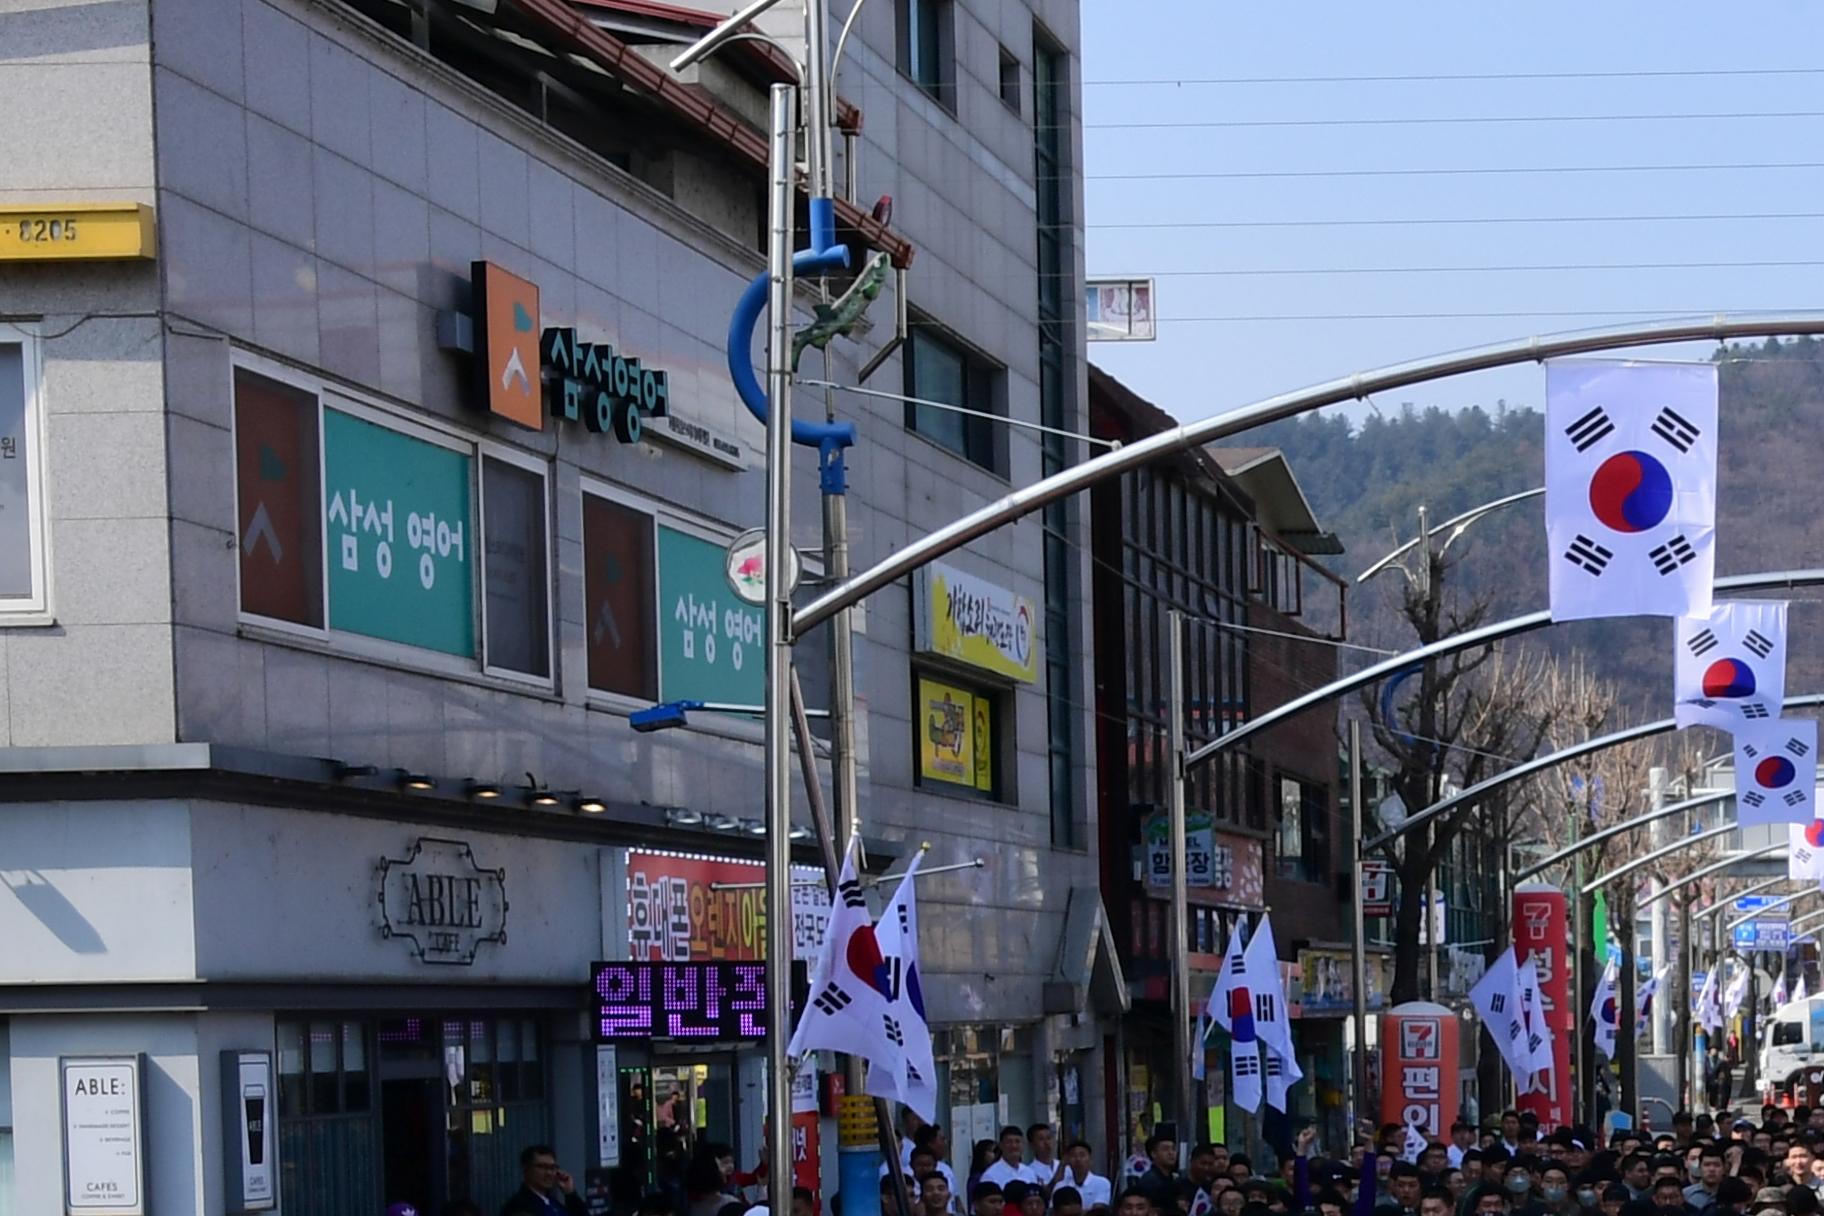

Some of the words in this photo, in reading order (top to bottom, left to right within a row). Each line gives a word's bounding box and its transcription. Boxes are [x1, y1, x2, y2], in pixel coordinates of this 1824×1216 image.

[551, 329, 671, 444] 삼성영어
[328, 489, 394, 579] 삼성
[407, 512, 464, 590] 영어
[675, 593, 717, 664] 삼성
[725, 608, 761, 671] 영어
[398, 873, 482, 928] ABLE
[632, 871, 692, 961] 휴대폰
